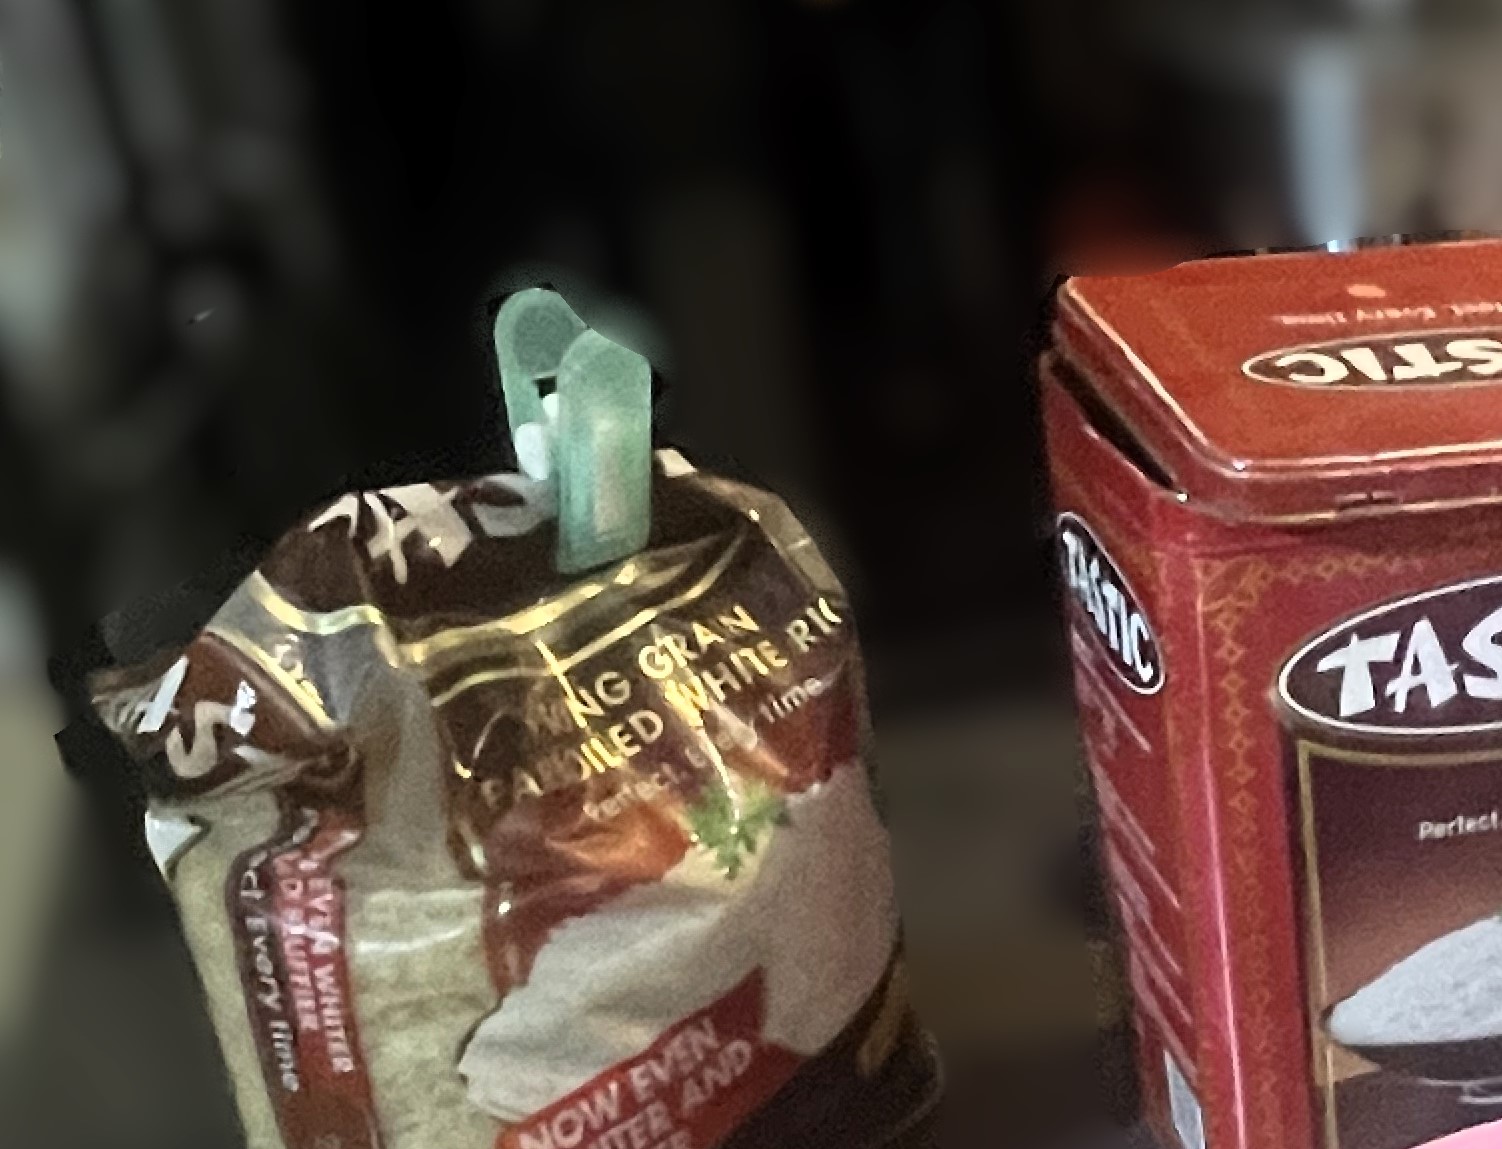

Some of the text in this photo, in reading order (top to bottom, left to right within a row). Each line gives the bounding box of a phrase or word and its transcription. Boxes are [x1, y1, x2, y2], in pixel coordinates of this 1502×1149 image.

[1062, 529, 1154, 683] TASTIC
[628, 1016, 718, 1102] EVEN
[680, 1039, 751, 1116] AND
